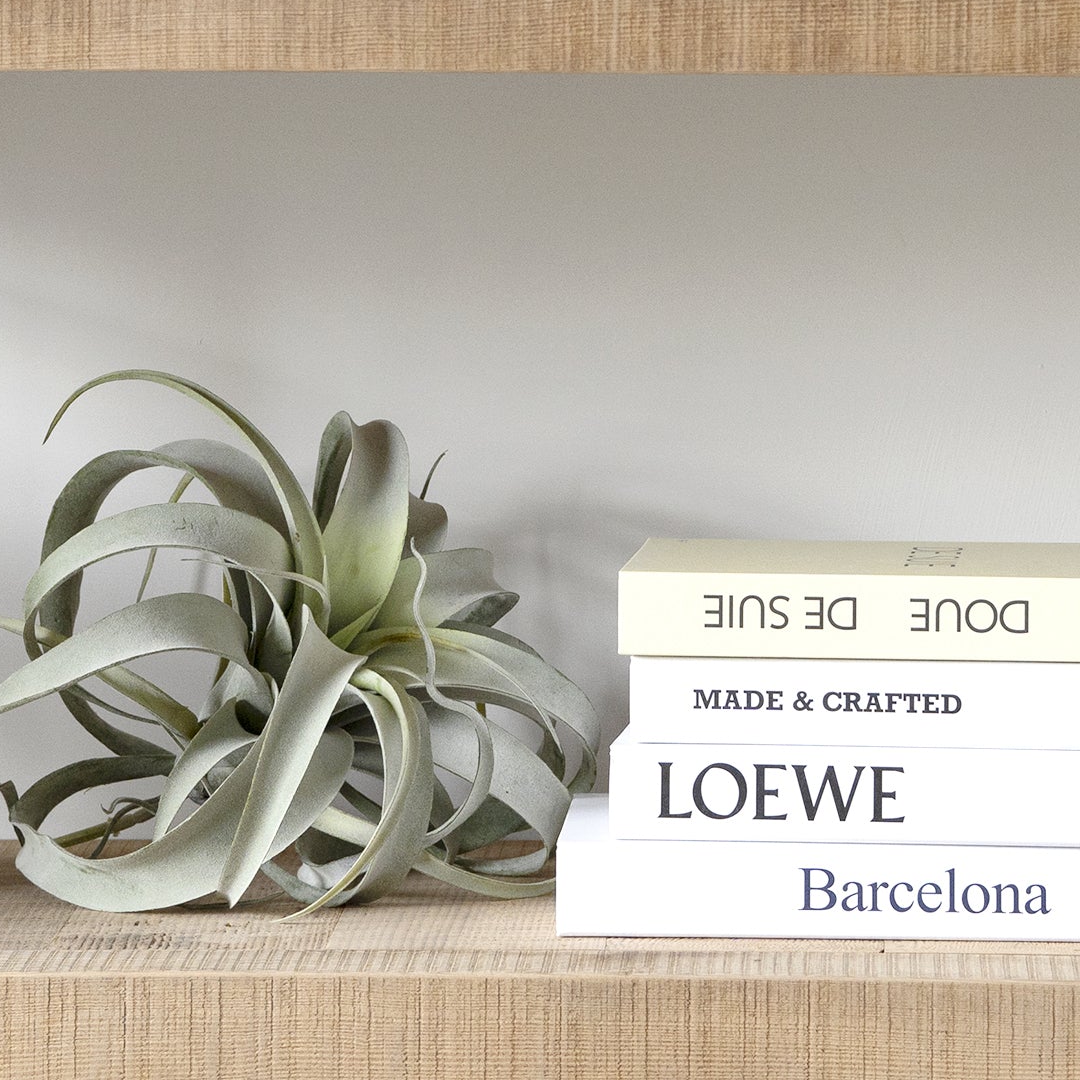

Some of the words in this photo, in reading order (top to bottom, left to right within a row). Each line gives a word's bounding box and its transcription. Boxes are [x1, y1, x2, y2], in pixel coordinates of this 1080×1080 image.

[703, 594, 790, 630] SUIE
[804, 596, 857, 631] DE
[909, 598, 1030, 634] DOUE
[693, 688, 784, 711] MADE
[792, 690, 814, 712] &
[822, 691, 963, 715] CRAFTED
[657, 761, 906, 824] LOEWE
[797, 867, 1052, 915] Barcelona
